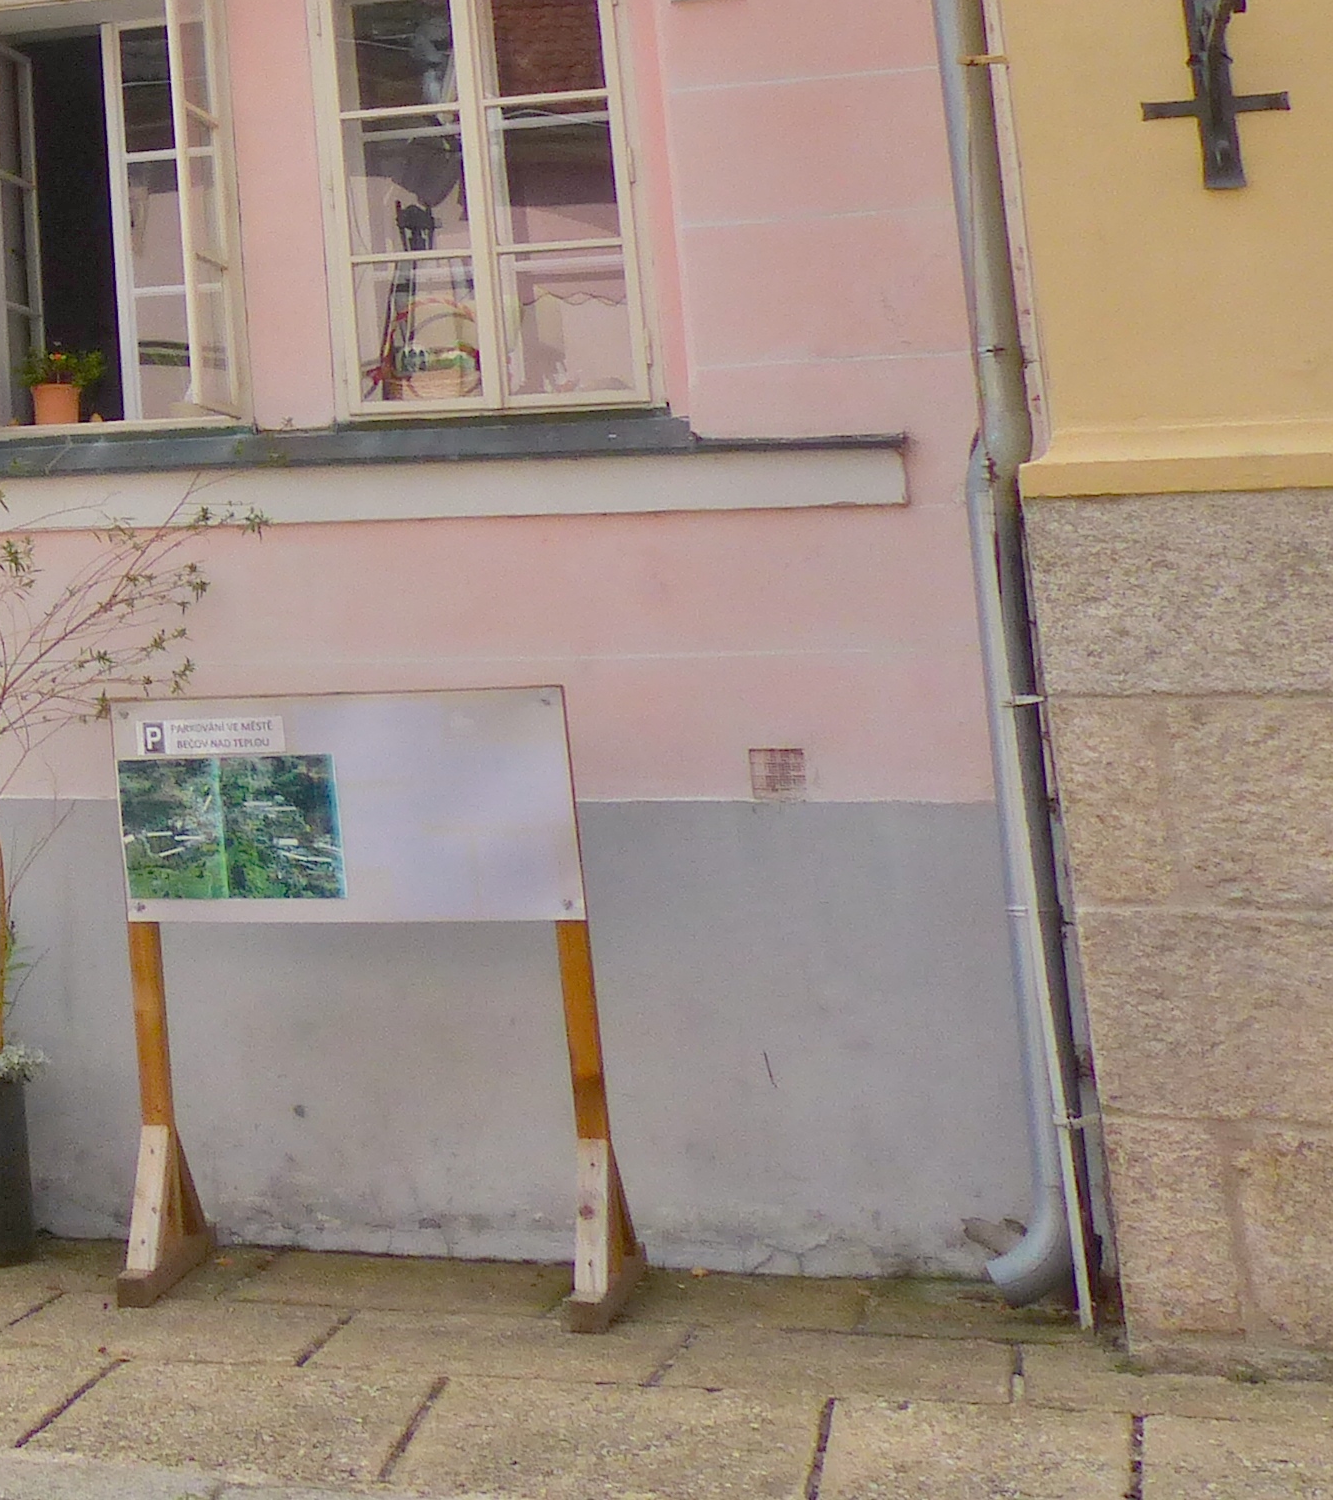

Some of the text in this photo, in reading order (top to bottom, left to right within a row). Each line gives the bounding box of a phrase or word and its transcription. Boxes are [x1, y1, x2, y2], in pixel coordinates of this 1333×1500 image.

[228, 722, 238, 732] VE
[145, 726, 162, 750] P
[210, 739, 231, 748] NAD
[233, 738, 270, 748] TEPLOU
